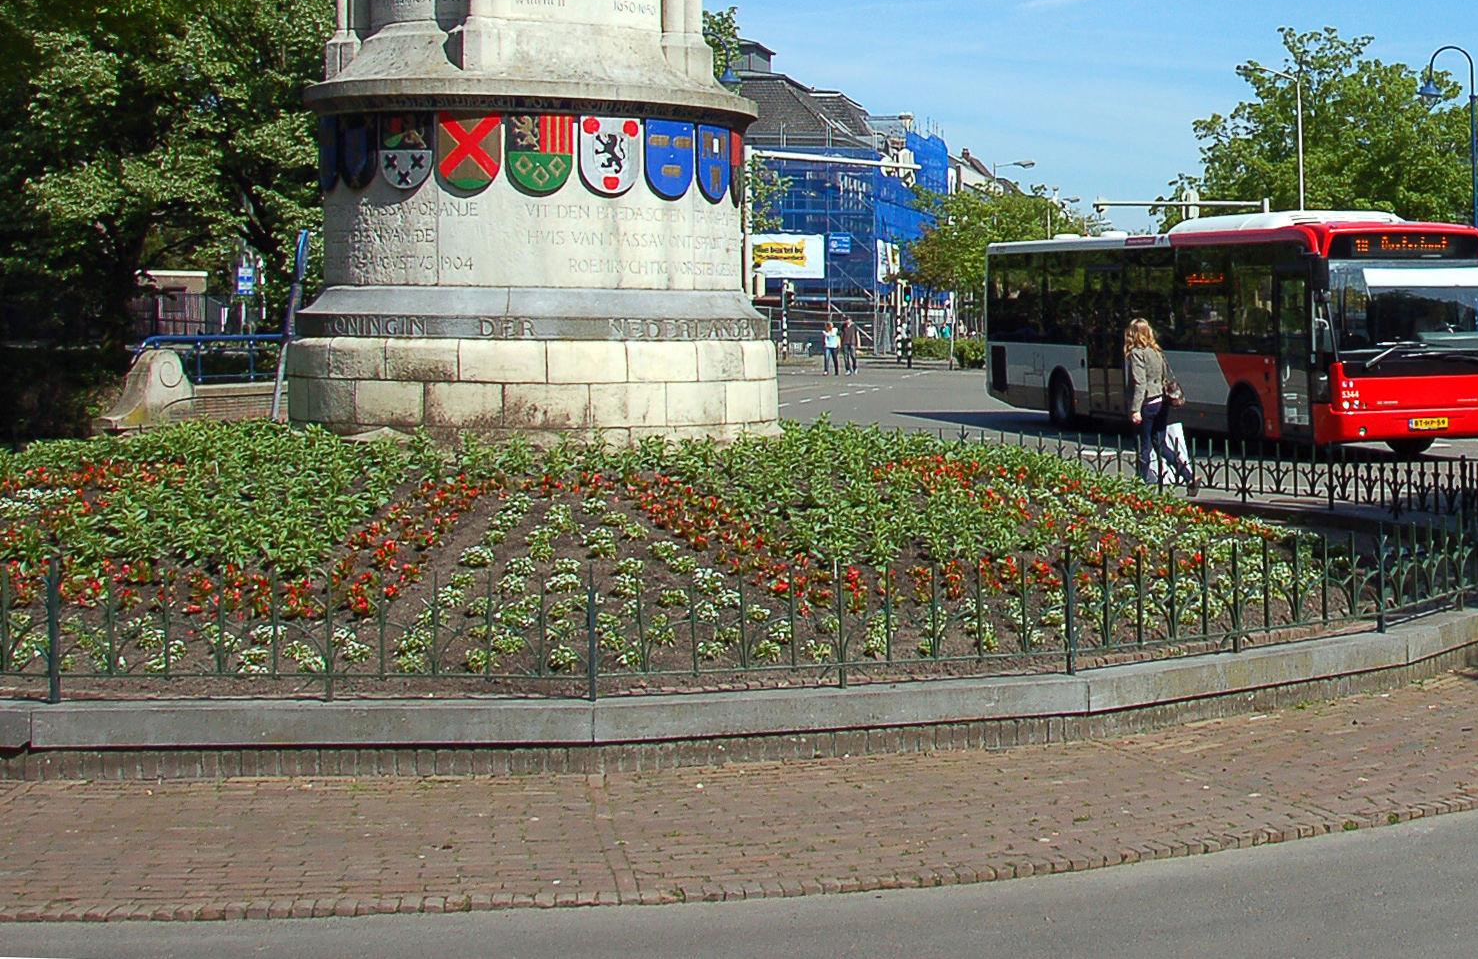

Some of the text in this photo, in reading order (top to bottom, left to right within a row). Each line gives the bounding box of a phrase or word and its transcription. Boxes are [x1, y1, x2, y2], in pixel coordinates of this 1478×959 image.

[556, 204, 590, 219] DEN
[597, 206, 686, 222] BREDASCHEN
[527, 230, 566, 245] HVIS
[571, 231, 604, 246] VAN
[440, 256, 474, 271] 1904
[479, 317, 538, 337] DER
